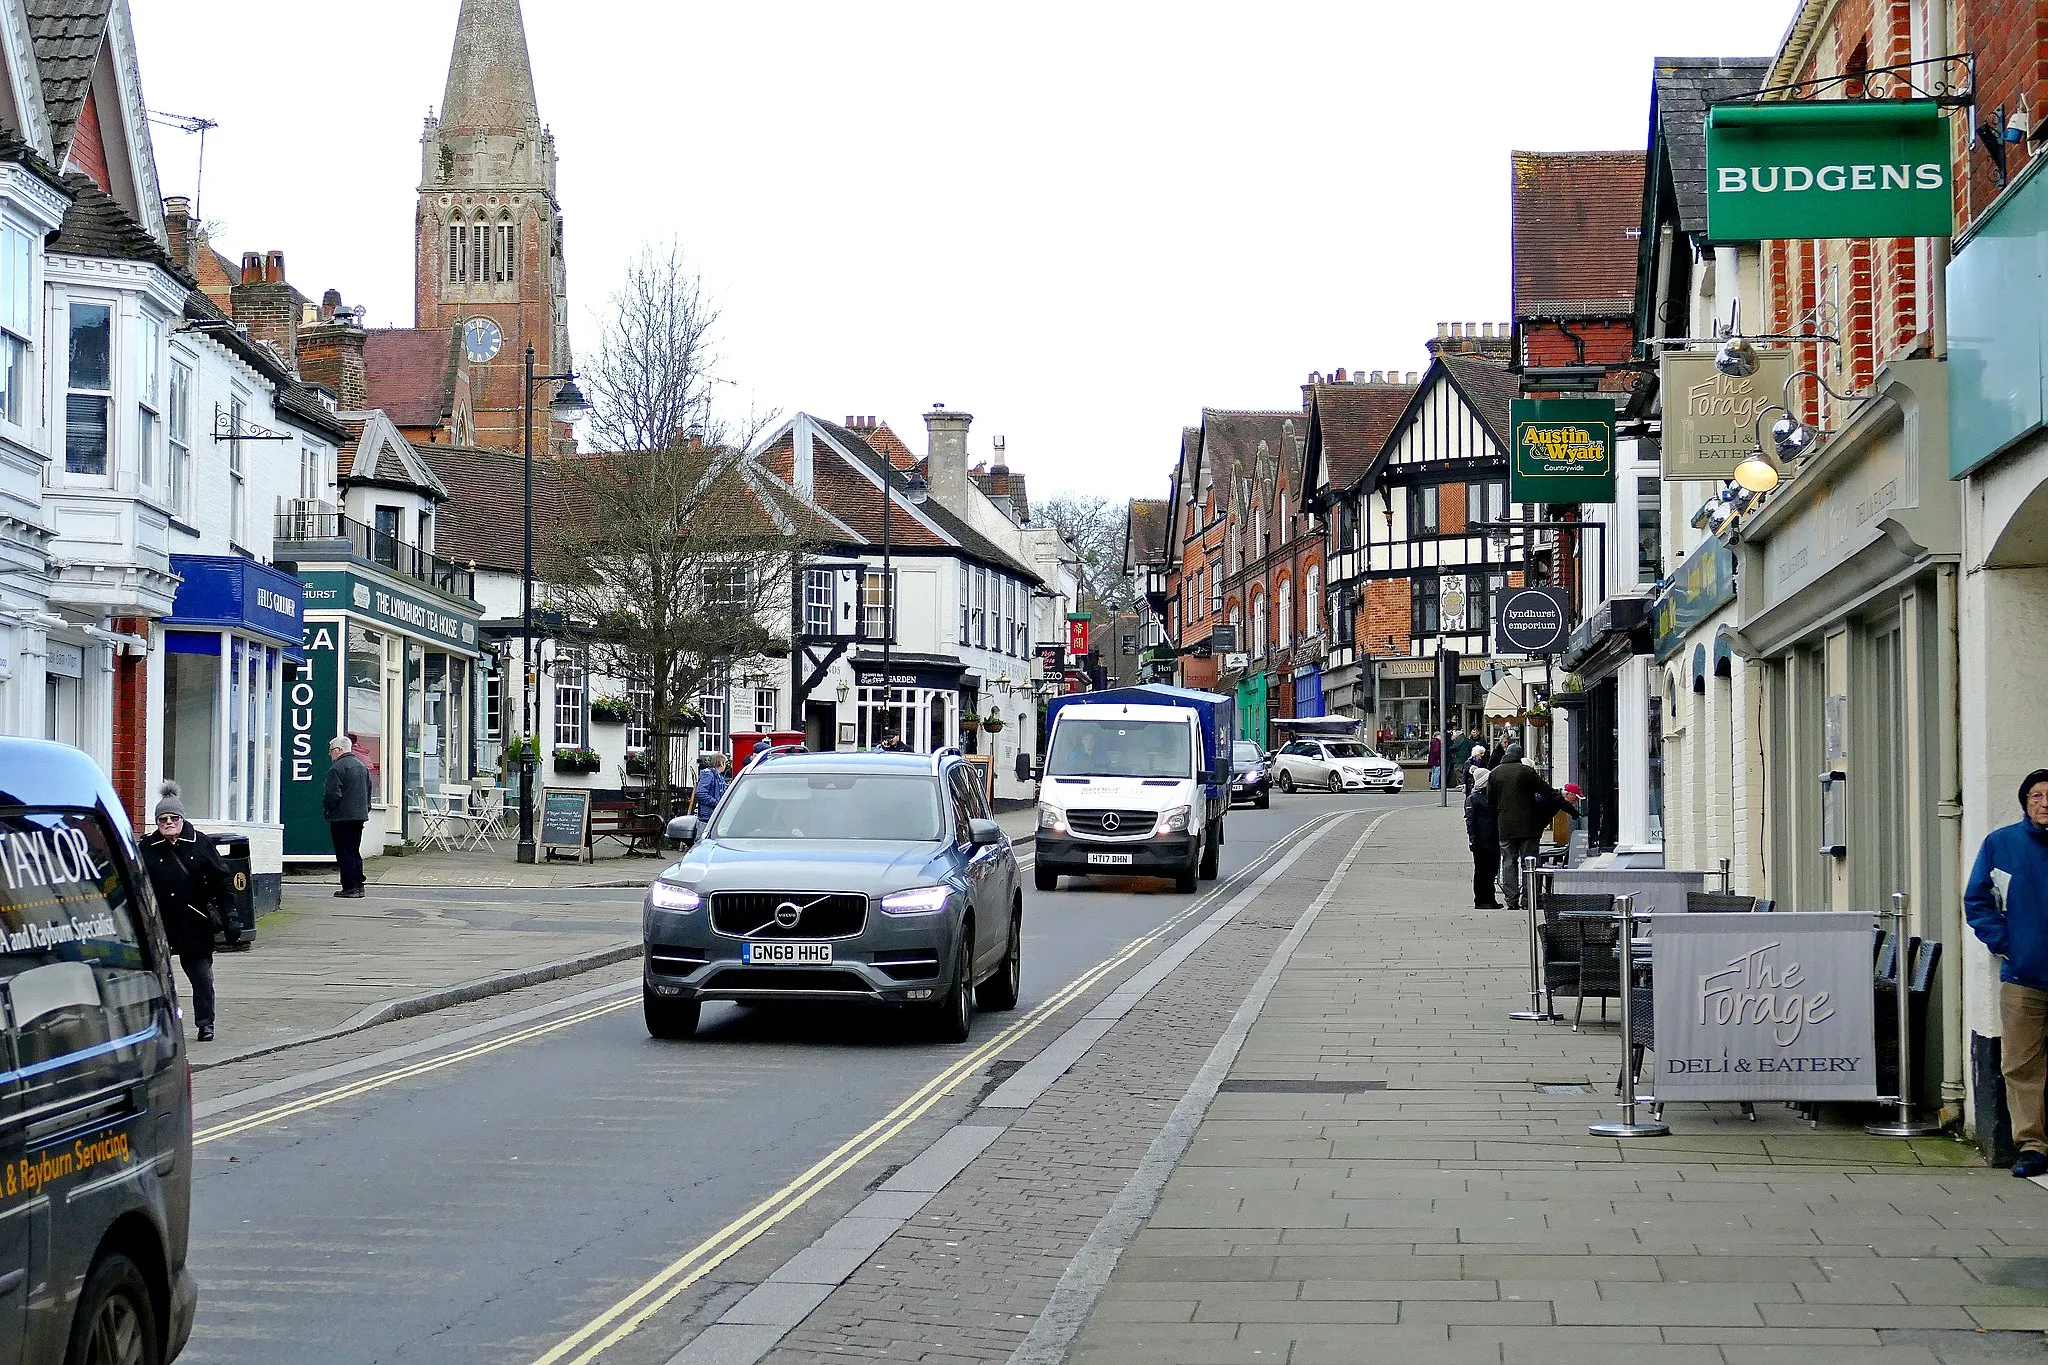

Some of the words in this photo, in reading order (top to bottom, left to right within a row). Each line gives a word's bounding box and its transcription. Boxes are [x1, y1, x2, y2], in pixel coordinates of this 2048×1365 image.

[1716, 163, 1944, 193] BUDGENS
[1705, 372, 1754, 395] The
[1688, 381, 1769, 428] Forage
[1523, 426, 1589, 444] Austin
[1742, 434, 1754, 444] &
[1530, 443, 1549, 459] &
[1546, 443, 1603, 463] Wyatt
[1698, 449, 1752, 459] EATER
[1543, 464, 1585, 472] Countrywide
[376, 591, 390, 615] THE
[390, 597, 426, 628] LYNDHURST
[426, 612, 438, 632] TEA
[439, 616, 458, 638] HOUSE
[1508, 609, 1556, 619] lyndhurst
[1508, 621, 1556, 630] emporium
[291, 658, 314, 781] HOUSE
[0, 828, 101, 889] TAYLOR
[1092, 854, 1110, 862] HT17
[1112, 855, 1128, 863] DHN
[9, 923, 31, 951] and
[29, 919, 75, 950] Rayburn
[71, 912, 117, 944] Specialist
[752, 945, 794, 960] GN68
[798, 945, 829, 960] HHG
[1727, 941, 1806, 990] The
[1697, 964, 1836, 1047] Forage
[1733, 1058, 1753, 1073] &
[1756, 1057, 1862, 1073] EATERY
[6, 1163, 17, 1196] &
[20, 1150, 73, 1195] Rayburn
[74, 1129, 130, 1171] Servicing
